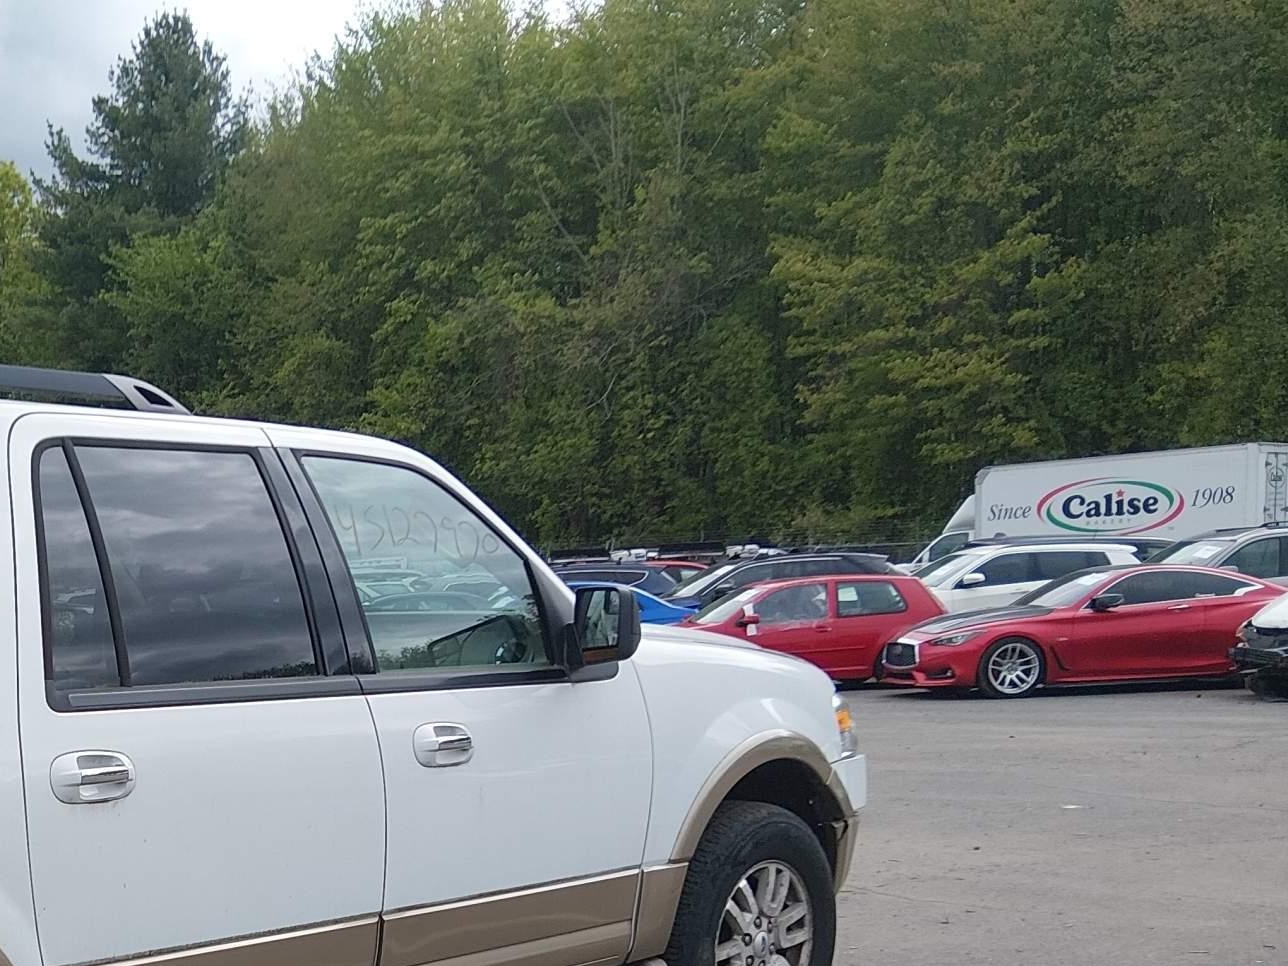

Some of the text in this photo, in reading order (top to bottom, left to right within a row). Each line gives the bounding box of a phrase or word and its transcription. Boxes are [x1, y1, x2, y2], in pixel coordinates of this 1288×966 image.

[1062, 489, 1159, 519] Calise
[1191, 486, 1235, 508] 1908
[987, 503, 1032, 521] Since
